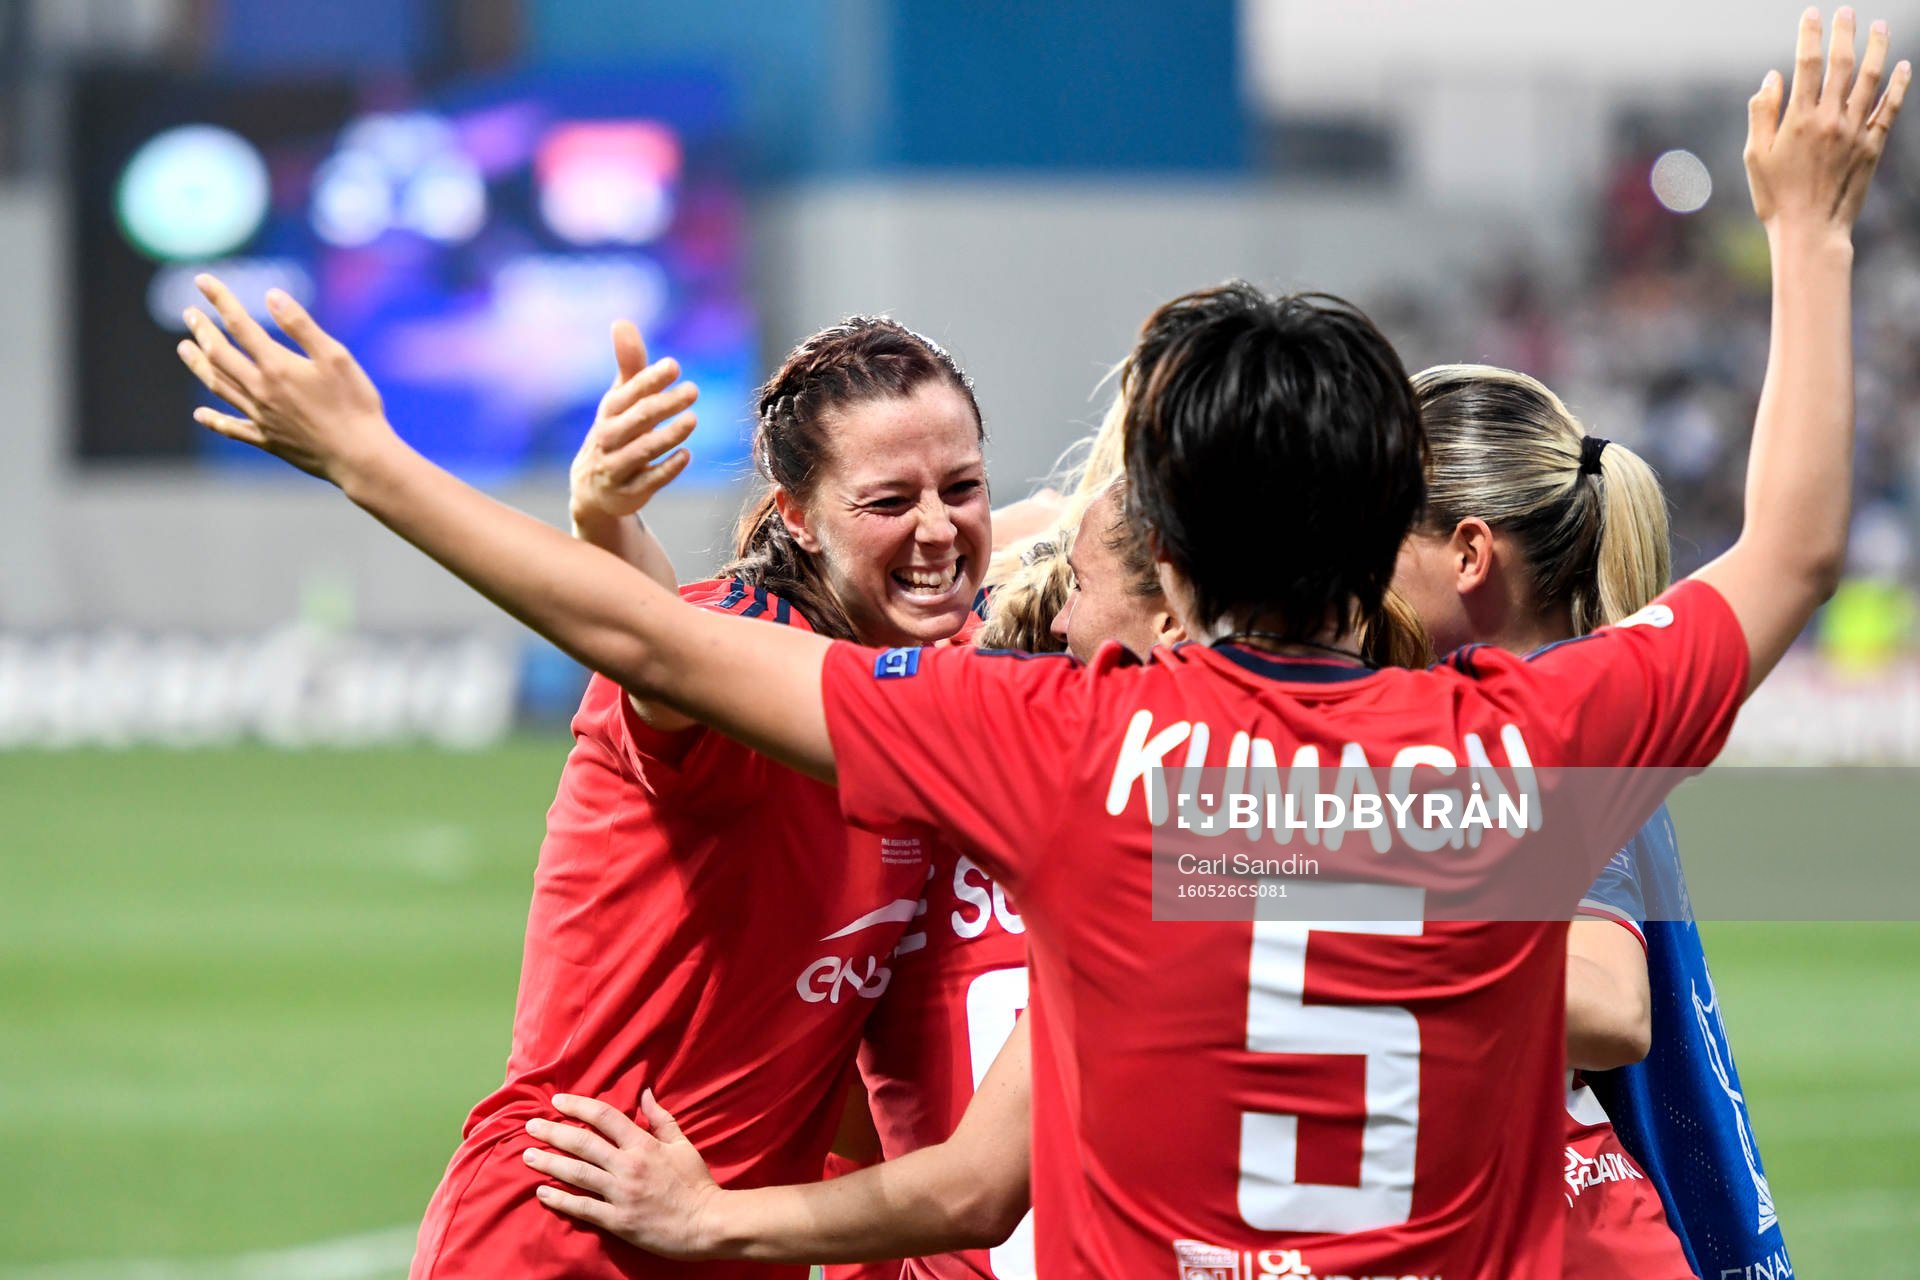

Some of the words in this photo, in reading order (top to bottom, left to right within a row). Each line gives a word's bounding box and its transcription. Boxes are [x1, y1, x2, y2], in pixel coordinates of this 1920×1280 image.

[1105, 709, 1544, 854] KUMAGAI
[1237, 878, 1426, 1235] 5
[1258, 1249, 1311, 1275] OL
